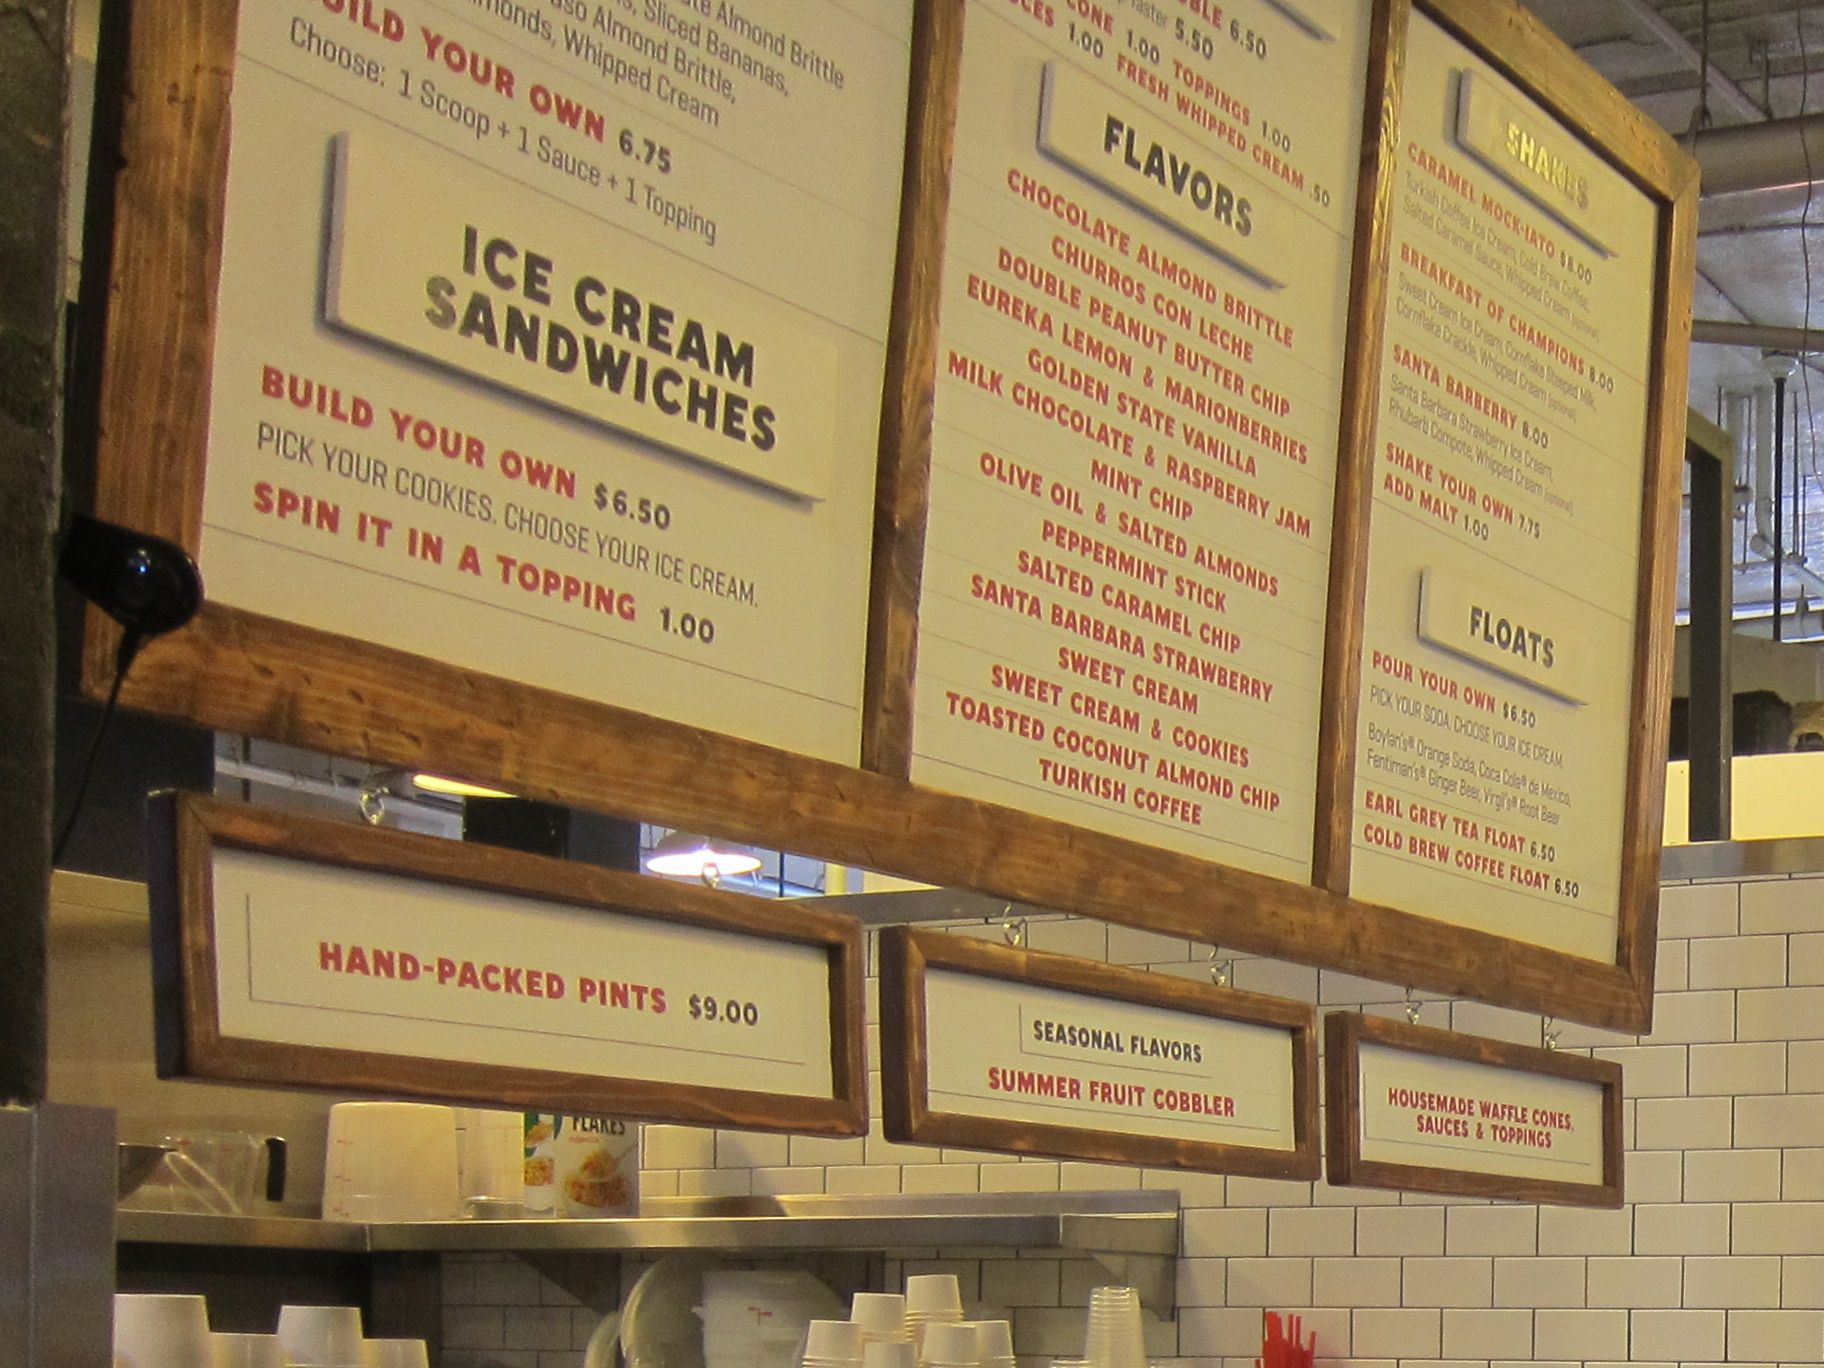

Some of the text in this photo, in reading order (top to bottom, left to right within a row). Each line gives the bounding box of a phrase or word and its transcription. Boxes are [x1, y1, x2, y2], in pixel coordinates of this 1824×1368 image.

[289, 15, 716, 247] Choose: 1 Scoop + 1 Sauce + 1 Topping
[1116, 52, 1169, 102] FRESH
[1175, 90, 1246, 152] WHIPPED
[1251, 143, 1304, 190] CREAM
[1407, 141, 1476, 204] CARAMEL
[1506, 119, 1589, 210] SHAKES
[1103, 114, 1251, 236] FLAVORS
[463, 225, 754, 388] ICE CREAM
[1006, 168, 1293, 348] CHOCOLATE ALMOND BRITTLE
[1051, 234, 1253, 364] CHURROS CON LECHE
[1400, 241, 1482, 308] BREAKFAST
[1486, 299, 1505, 323] OF
[1508, 313, 1584, 376] CHAMPIONS
[425, 276, 775, 451] SANDWICHES
[966, 273, 1307, 465] EUREKA LEMON & MARIONBERRIES
[997, 246, 1290, 417] DOUBLE PEANUT BUTTER CHIP
[1027, 347, 1256, 477] GOLDEN STATE VANILLA
[1392, 343, 1440, 387] SANTA
[1445, 374, 1517, 430] BARBERRY
[261, 364, 670, 530] BUILD YOUR OWN $6.50
[948, 350, 1310, 538] MILK CHOCOLATE & RASPBERRY JAM
[1090, 458, 1193, 521] MINT CHIP
[1385, 441, 1540, 539] SHAKE YOUR OWN 7.75
[257, 420, 758, 607] PICK YOUR COOKIES. CHOOSE YOUR ICE CREAM.
[979, 451, 1278, 597] OLIVE OIL & SALTED ALMONDS
[1383, 472, 1489, 541] ADD MALT 1.00
[253, 481, 714, 644] SPIN IT IN A TOPPING 1.00
[1017, 549, 1241, 654] SALTED CARAMEL CHIP
[1041, 518, 1226, 613] PEPPERMINT STICK
[970, 573, 1273, 702] SANTA BARBARA STRAWBERRY
[1058, 646, 1198, 714] SWEET CREAM
[1372, 649, 1536, 728] POUR YOUR OWN $6.50
[1469, 605, 1553, 668] FLOATS
[945, 690, 1280, 812] TOASTED COCONUT ALMOND CHIP
[991, 663, 1249, 768] SWEET CREAM & COOKIES
[1038, 757, 1201, 825] TURKISH COFFEE
[1364, 789, 1555, 862] EARL GREY TEA FLOAT 6.50
[1363, 822, 1579, 898] COLD BREW COFFEE FLOAT 6.50
[319, 941, 759, 1027] HAND-PACKED PINTS $9.00
[988, 1066, 1235, 1117] SUMMER FRUIT COBBLER
[1033, 1019, 1202, 1063] SEASONAL FLAVORS
[1388, 1087, 1571, 1131] HOUSEMADE WAFFLE CONES,
[1416, 1113, 1552, 1149] SAUCES & TOPPINGS
